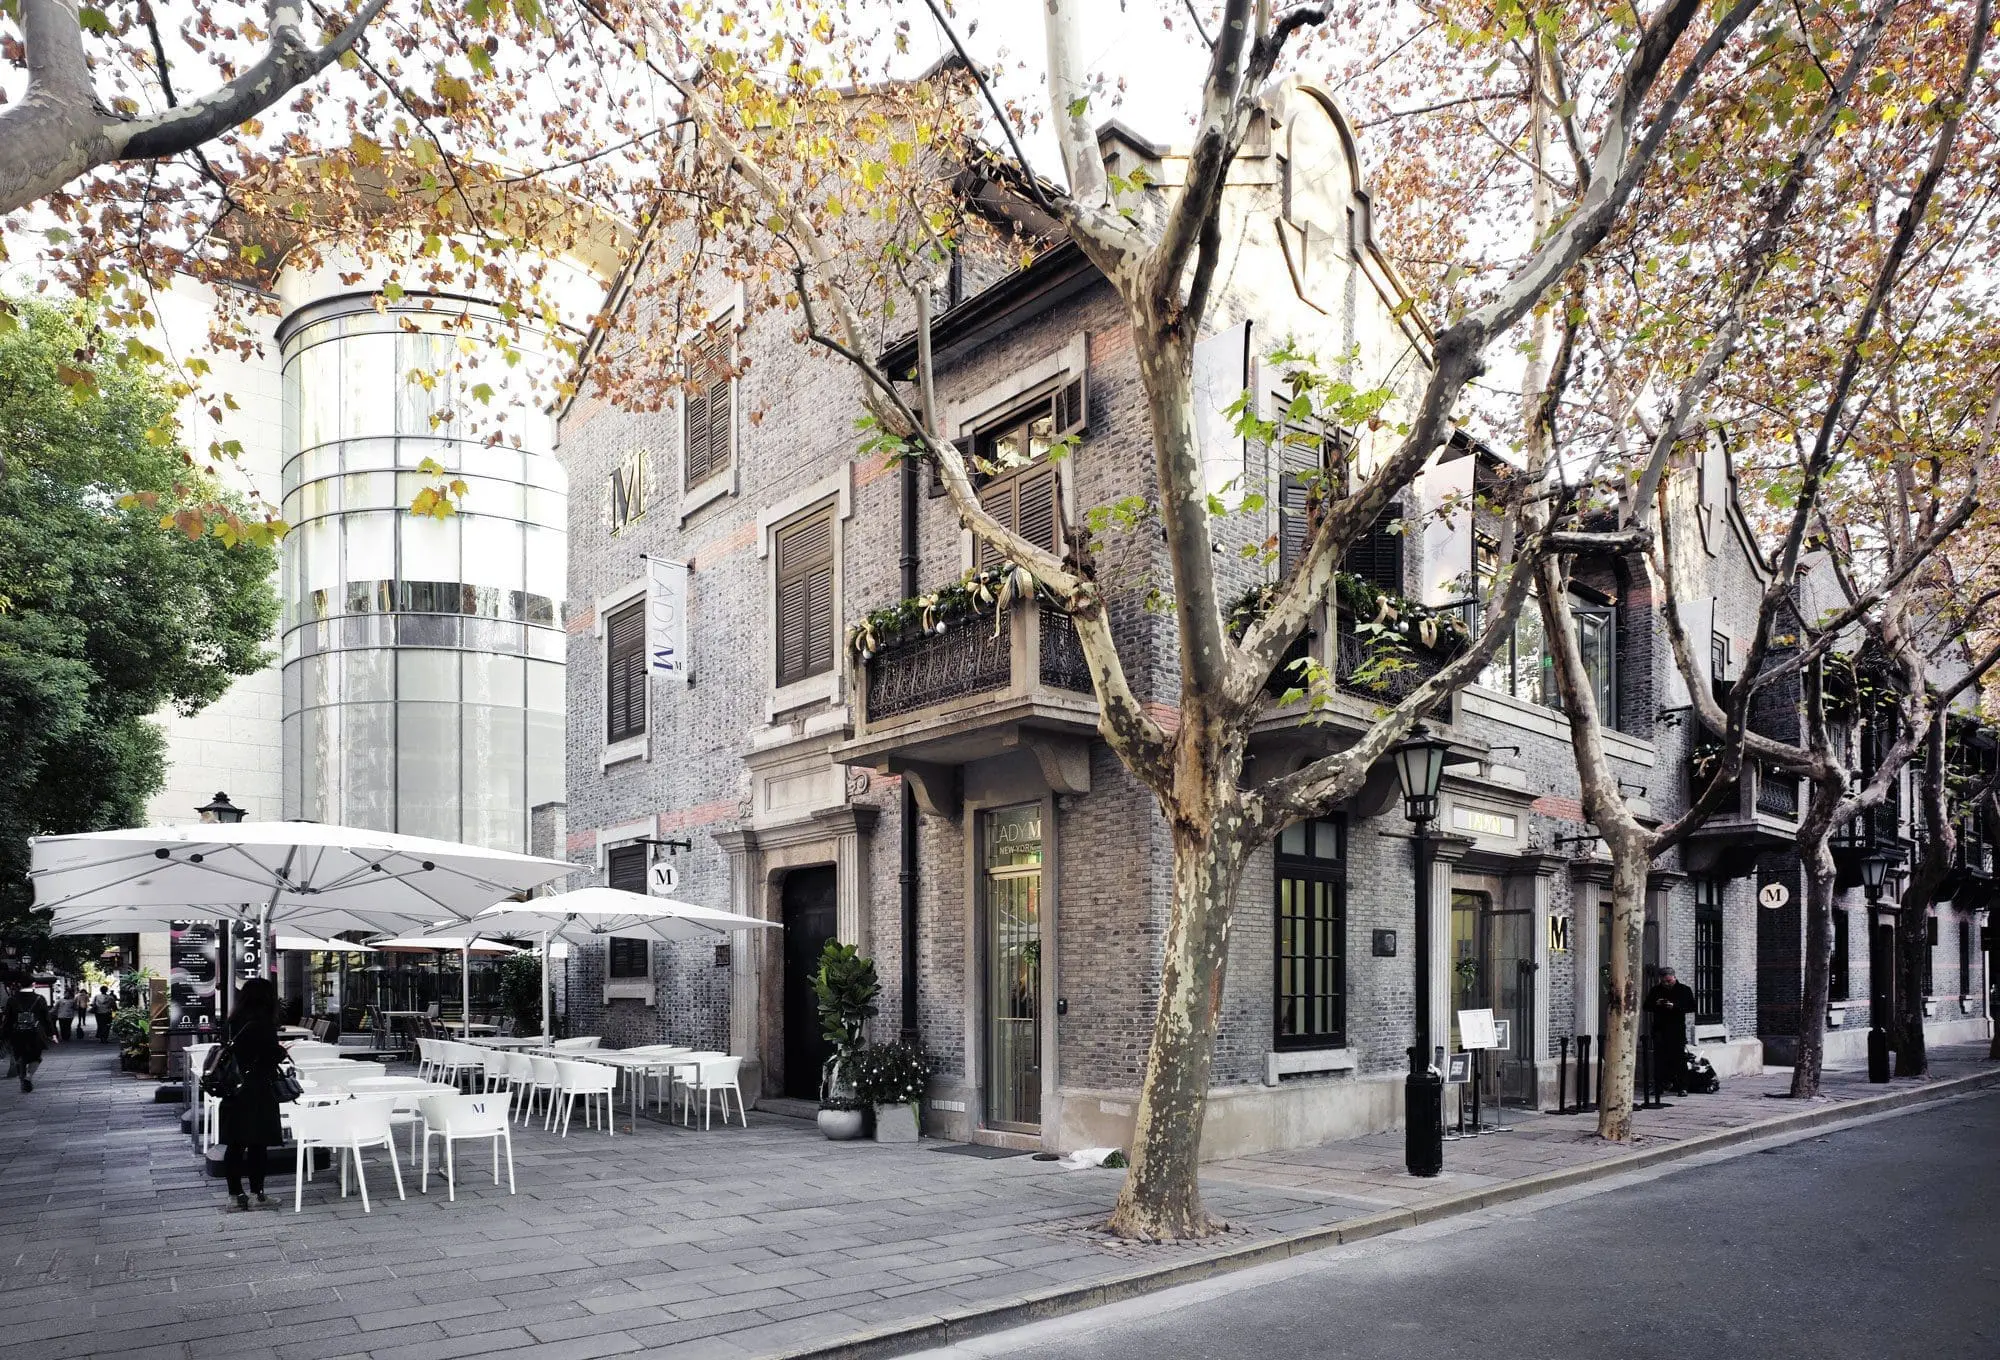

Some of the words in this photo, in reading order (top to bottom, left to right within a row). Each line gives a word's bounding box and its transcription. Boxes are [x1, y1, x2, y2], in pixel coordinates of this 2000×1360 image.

[608, 448, 647, 537] M
[655, 868, 673, 885] M
[1764, 888, 1781, 902] M
[1549, 915, 1569, 950] M
[472, 1103, 485, 1114] M
